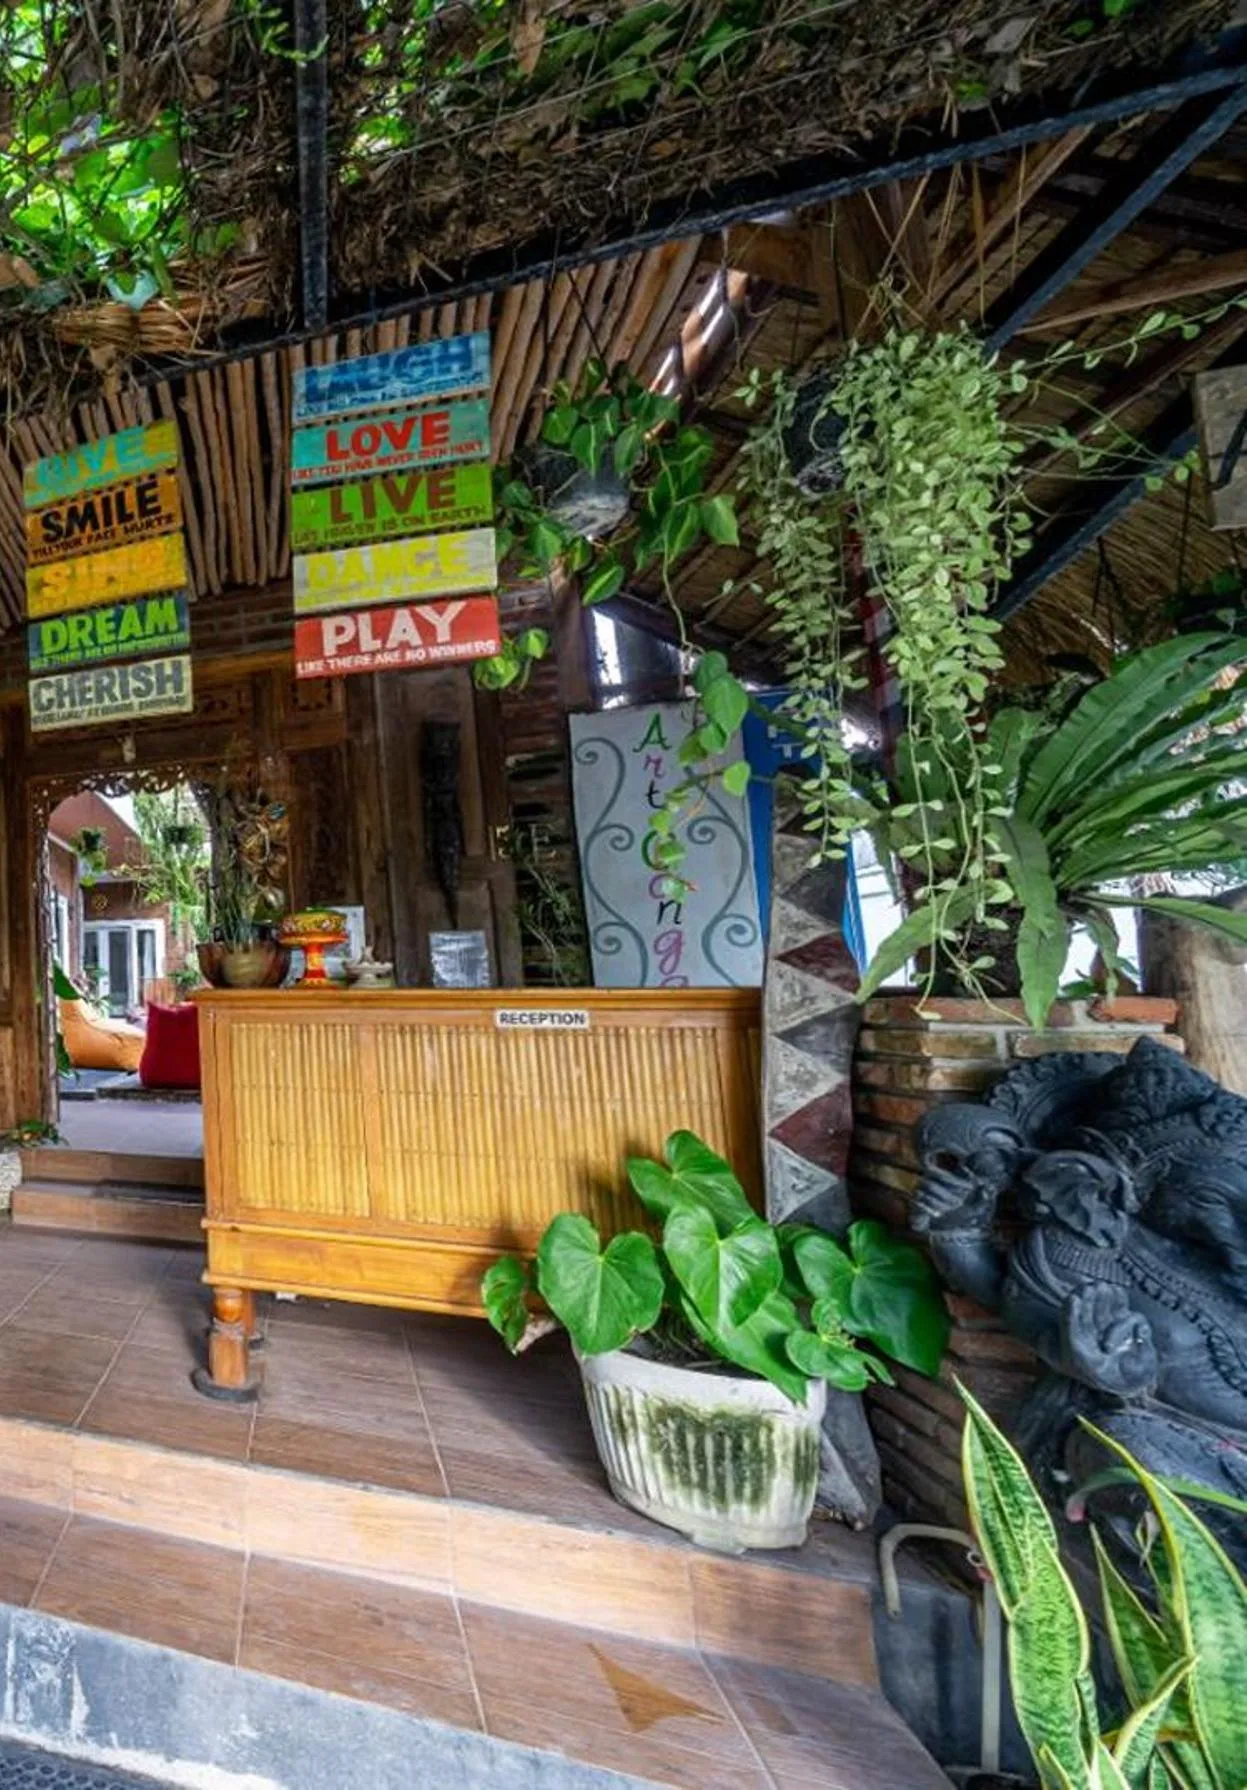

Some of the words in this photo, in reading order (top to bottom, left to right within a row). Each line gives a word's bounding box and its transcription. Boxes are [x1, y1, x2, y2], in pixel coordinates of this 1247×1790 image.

[326, 411, 450, 462] LOVE
[41, 480, 162, 541] SMILE
[330, 469, 456, 523] LIVE
[308, 533, 469, 589] DANCE
[41, 597, 178, 655] DREAM
[321, 600, 468, 657] PLAY
[374, 650, 401, 664] ARE
[405, 647, 426, 661] NO
[429, 639, 496, 659] WINNERS
[32, 660, 184, 712] CHERISH
[499, 1011, 585, 1026] RECEPTION
